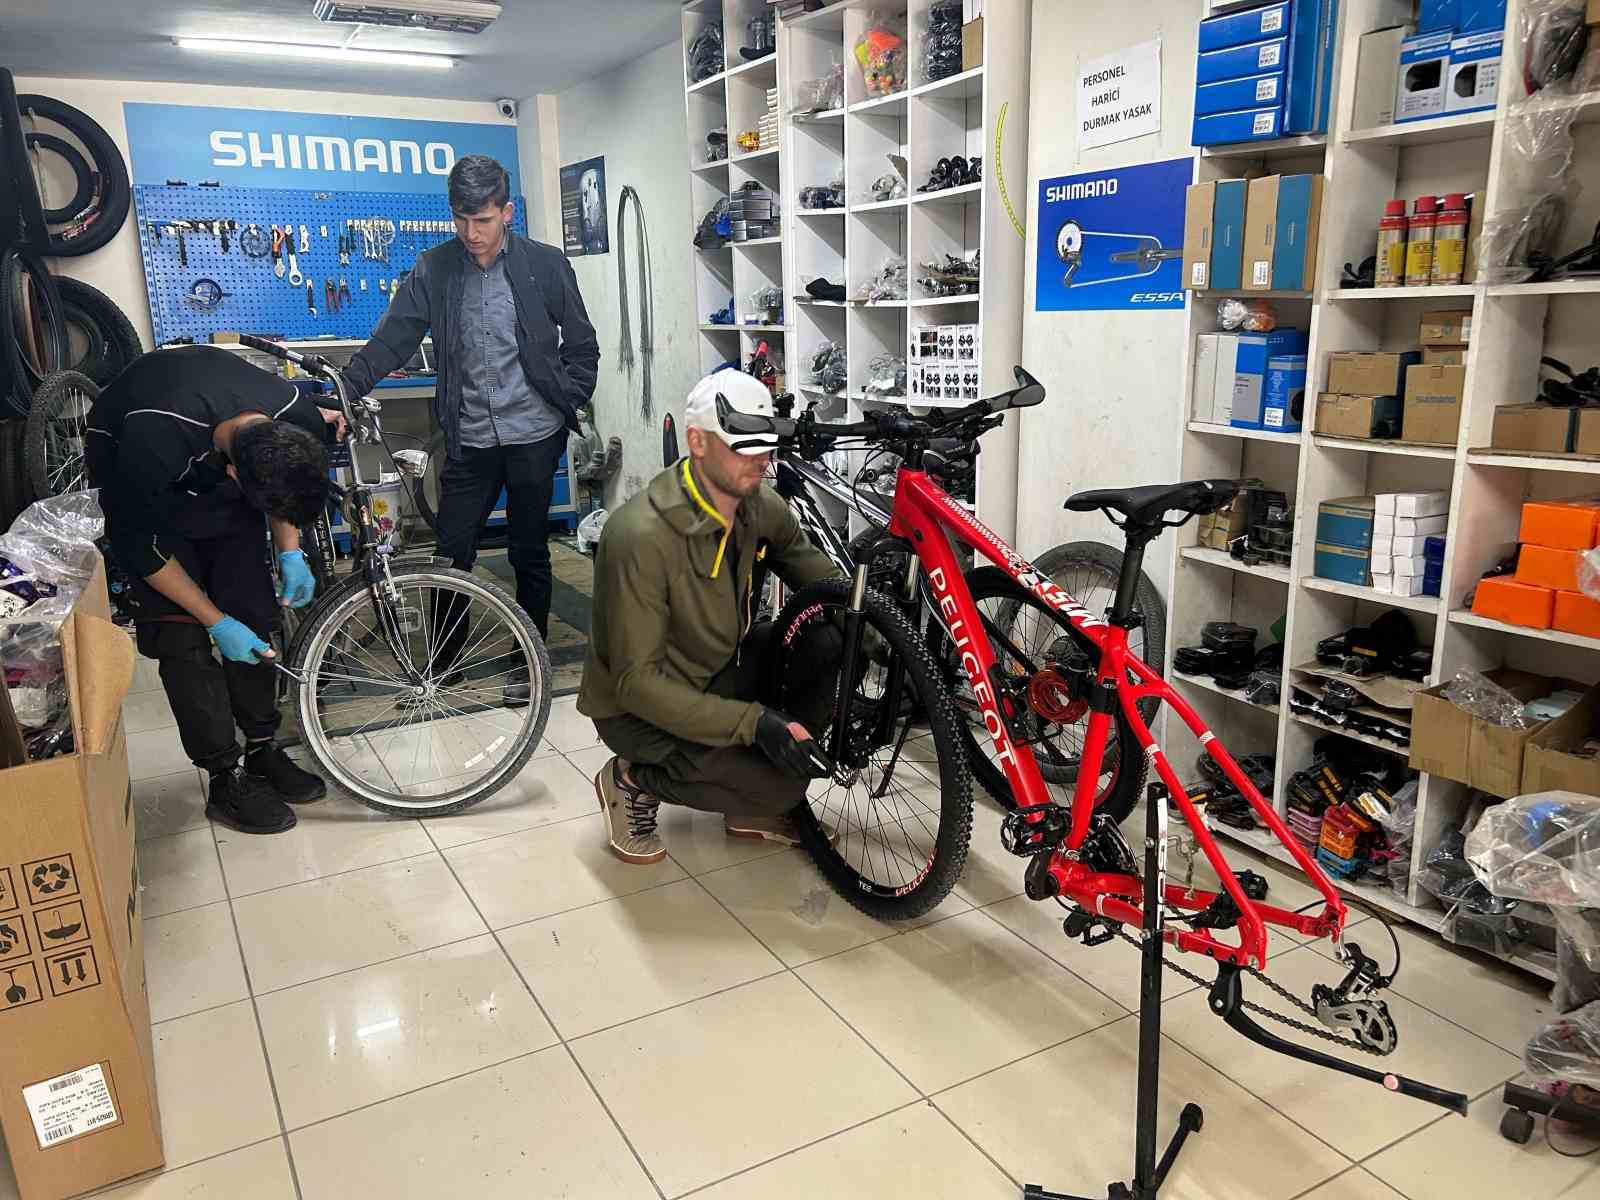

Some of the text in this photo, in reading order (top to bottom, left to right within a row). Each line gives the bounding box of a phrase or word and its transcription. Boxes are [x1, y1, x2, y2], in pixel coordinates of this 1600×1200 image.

[1083, 65, 1126, 88] PERSONEL
[1091, 87, 1120, 107] HARİCİ
[1083, 103, 1152, 131] DURMAK YASAK
[209, 130, 456, 176] SHIMANO
[1046, 178, 1118, 203] SHIMANO
[929, 567, 1016, 777] PEUGEOT
